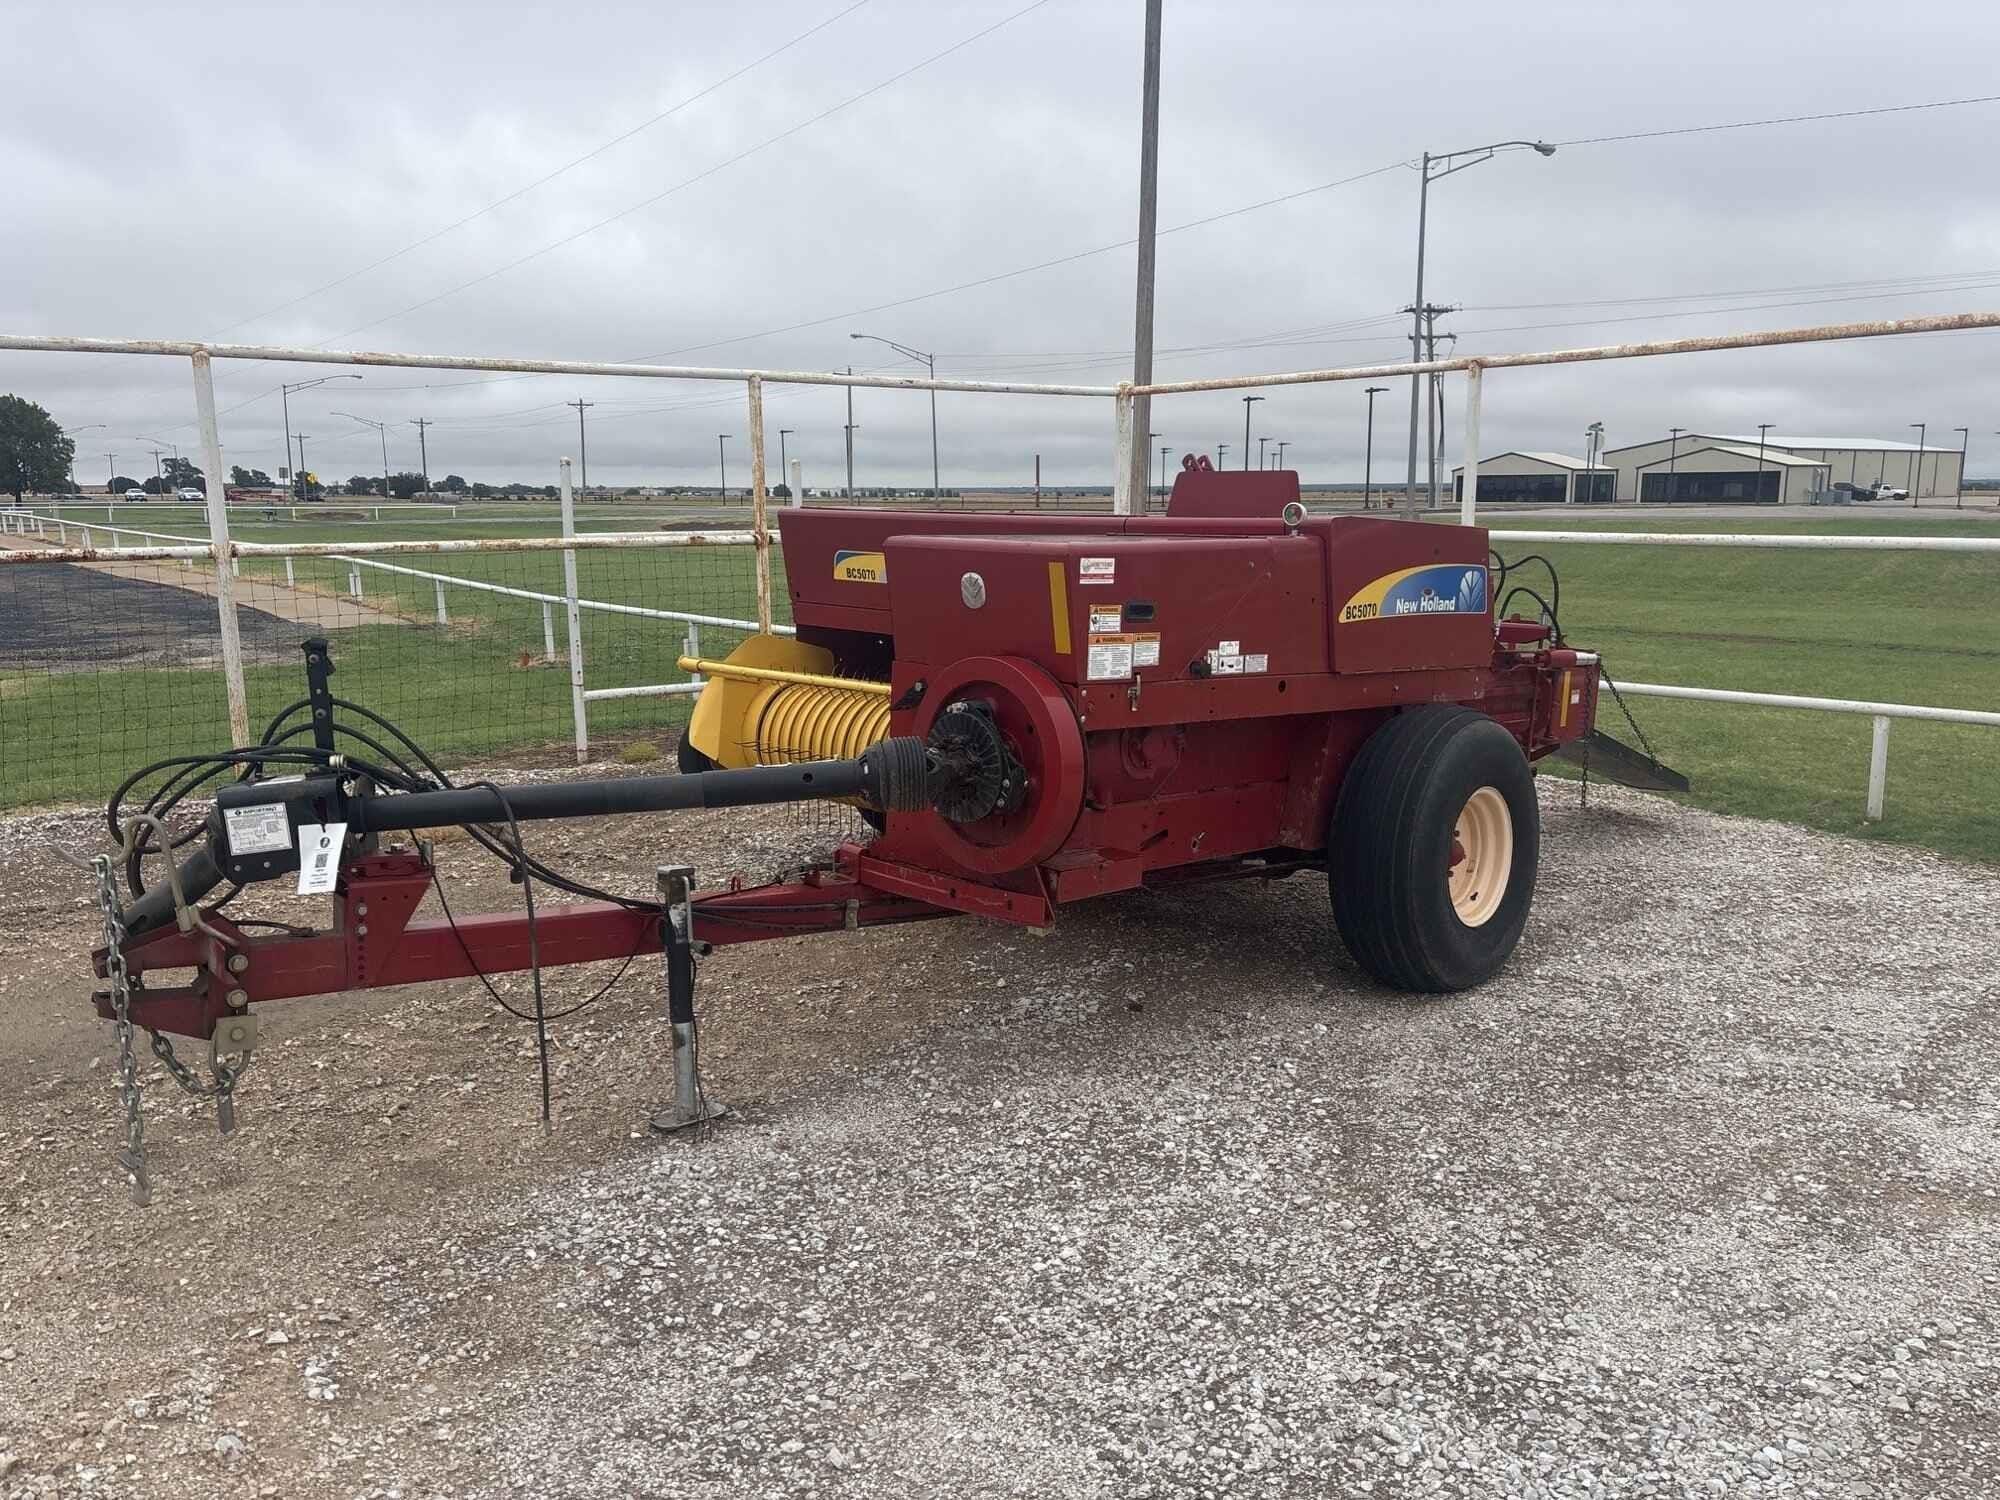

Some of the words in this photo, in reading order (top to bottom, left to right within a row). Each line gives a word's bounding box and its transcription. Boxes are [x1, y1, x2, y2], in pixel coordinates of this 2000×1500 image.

[846, 568, 876, 580] BC5070
[1345, 603, 1377, 619] BC5070
[1396, 599, 1418, 614] New
[1420, 596, 1456, 612] Holland
